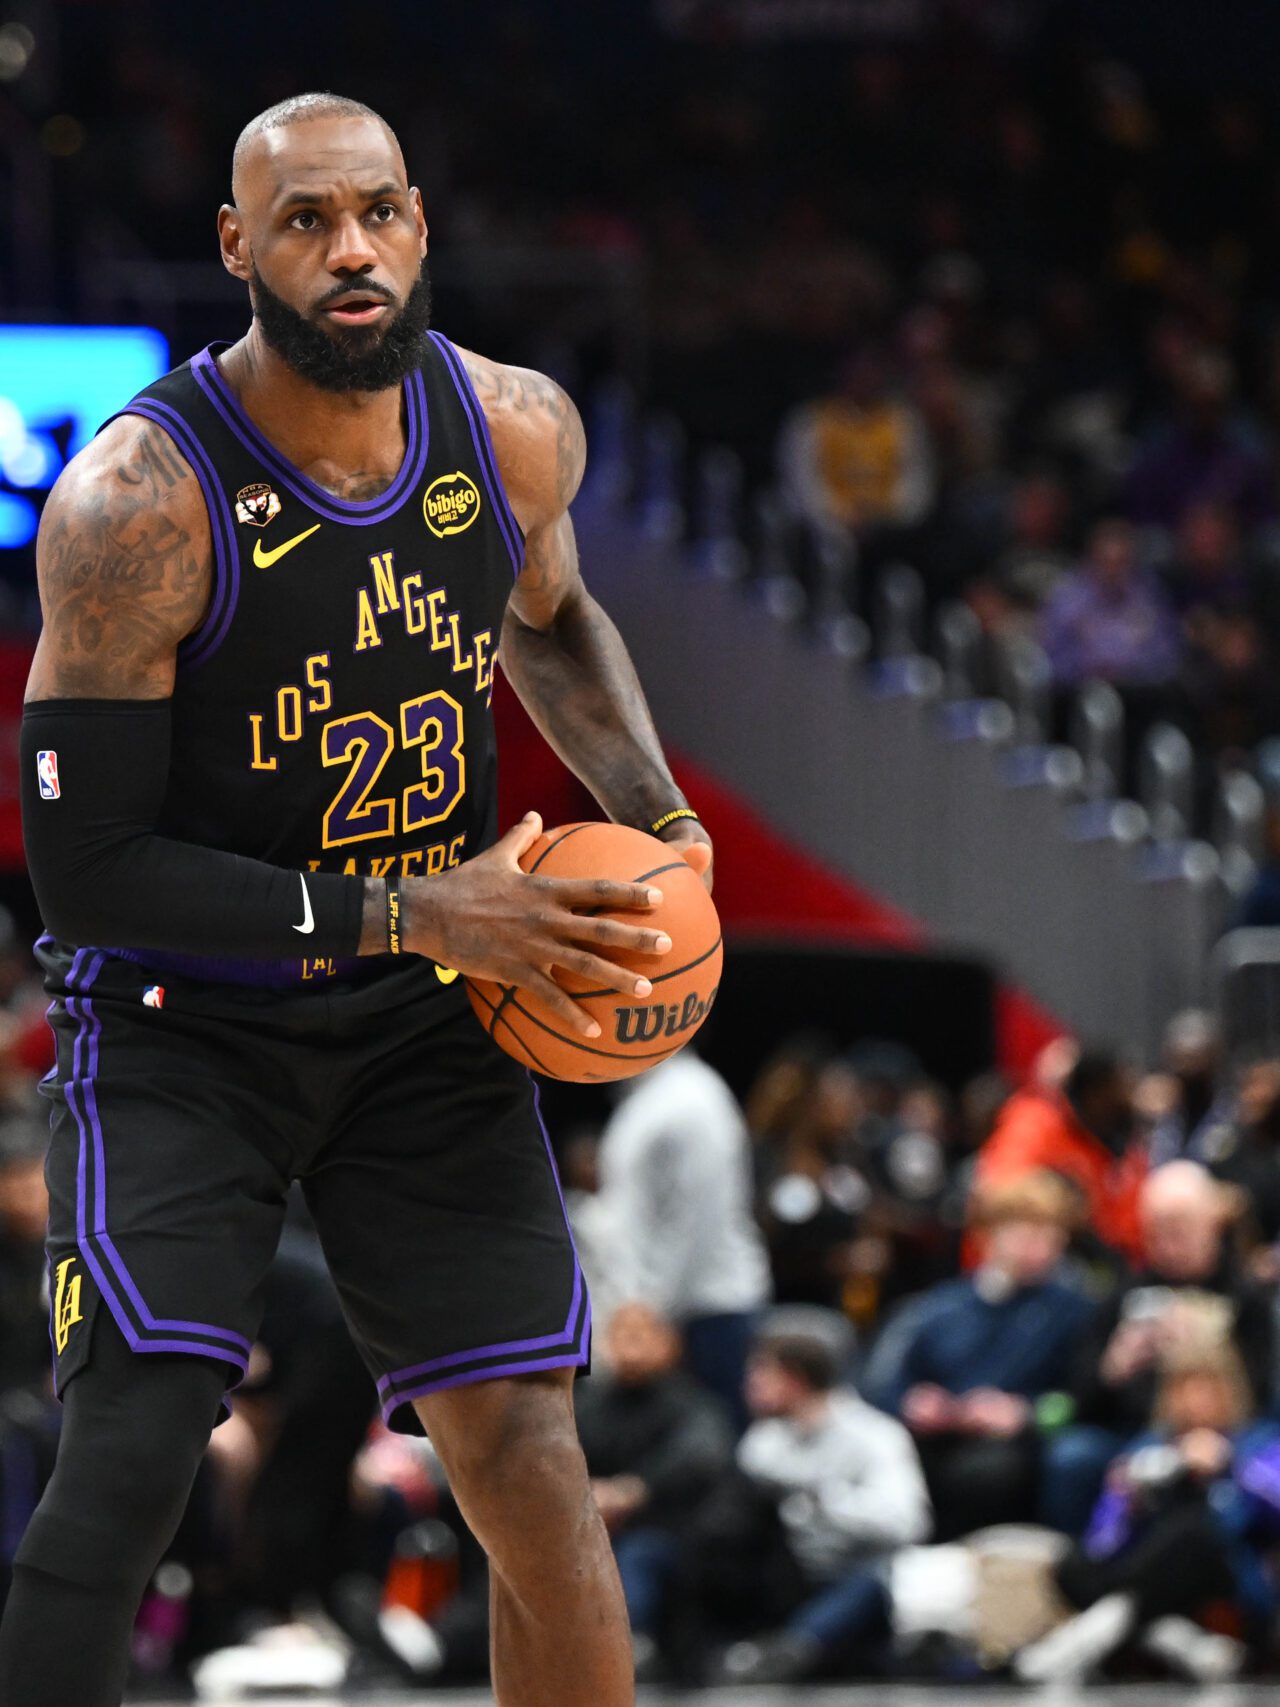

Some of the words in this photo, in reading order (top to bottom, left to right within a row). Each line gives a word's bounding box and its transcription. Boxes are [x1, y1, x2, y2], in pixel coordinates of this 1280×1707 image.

[427, 489, 476, 518] bibigo
[248, 652, 332, 771] LOS
[321, 690, 466, 849] 23
[614, 986, 719, 1044] Wils
[54, 1257, 83, 1356] LA
